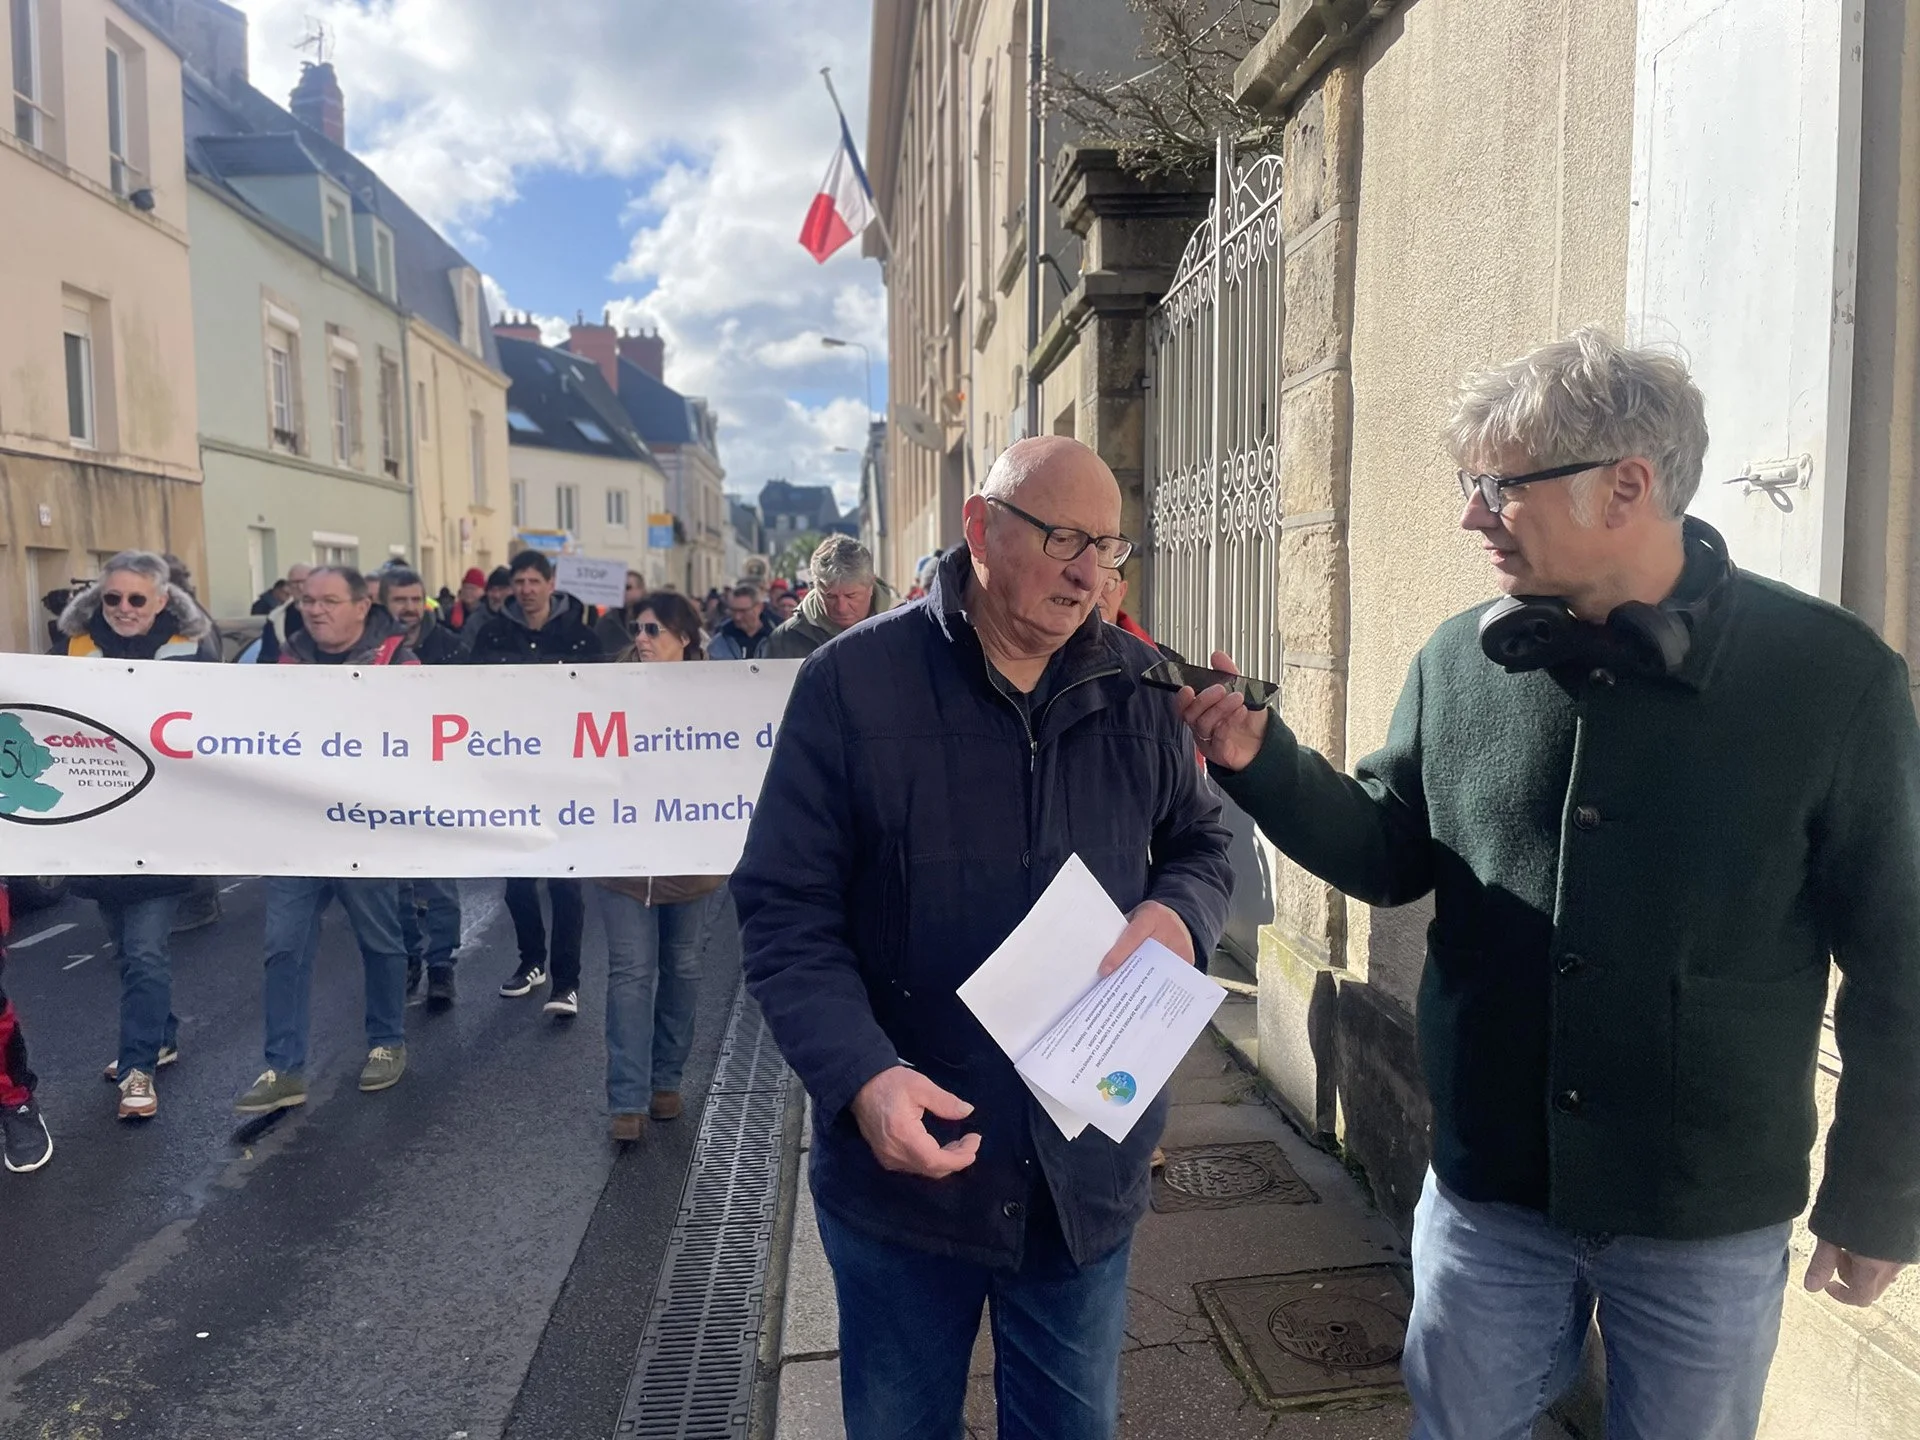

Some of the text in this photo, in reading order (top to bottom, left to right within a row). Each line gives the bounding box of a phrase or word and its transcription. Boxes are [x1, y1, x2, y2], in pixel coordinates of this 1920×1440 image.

[575, 566, 608, 580] STOP
[149, 711, 773, 762] Comité de la Pêche Maritime d
[0, 739, 38, 778] 50
[71, 757, 87, 765] LA
[68, 768, 130, 777] MARITIME
[97, 780, 135, 788] LOISIR
[326, 794, 754, 830] département de la Manch
